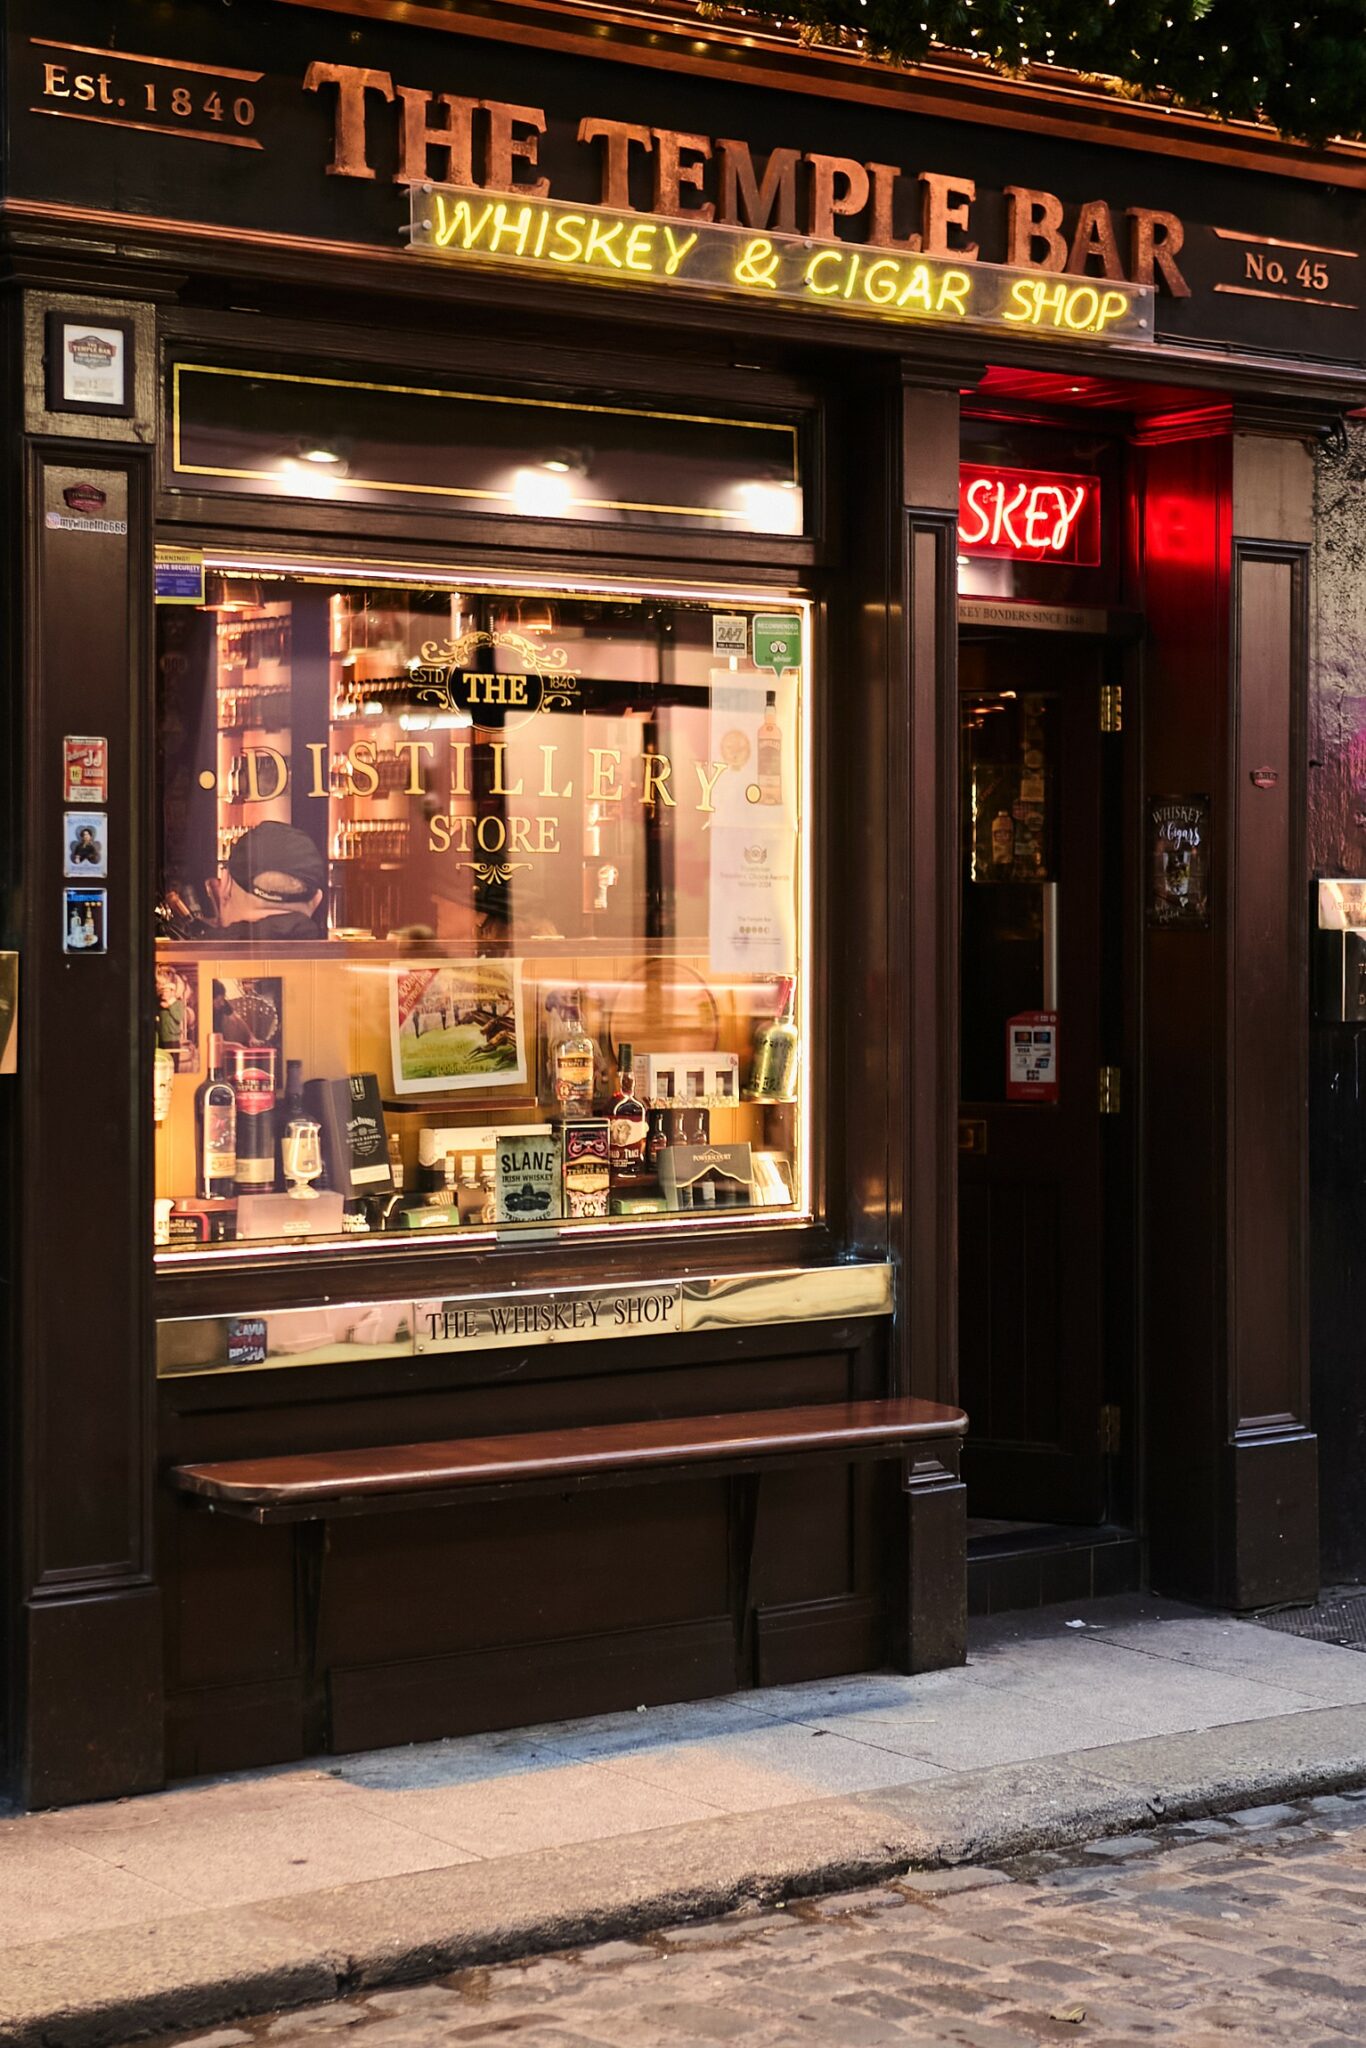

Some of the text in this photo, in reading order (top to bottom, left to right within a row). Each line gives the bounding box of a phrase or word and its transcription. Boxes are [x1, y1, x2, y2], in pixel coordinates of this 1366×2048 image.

[43, 63, 256, 126] Est. 1840
[303, 61, 1192, 298] THE TEMPLE BAR
[433, 195, 1128, 331] WHISKEY & CIGAR SHOP
[1244, 252, 1330, 290] No. 45
[957, 479, 1085, 550] SKEY
[757, 622, 799, 631] RECOMMENDED
[983, 608, 1031, 622] BONDERS
[1033, 612, 1061, 625] SINCE
[409, 668, 444, 683] ESTD
[462, 673, 528, 705] THE
[549, 675, 577, 690] 1840
[241, 739, 727, 813] DISTILLERY
[1152, 806, 1203, 824] WHISKEY
[428, 814, 560, 854] STORE
[1167, 821, 1201, 850] Cigars
[501, 1151, 555, 1174] SLANE
[567, 1167, 595, 1175] TEMPLE
[502, 1173, 553, 1183] IRISH WHISKEY
[425, 1295, 674, 1341] THE WHISKEY SHOP
